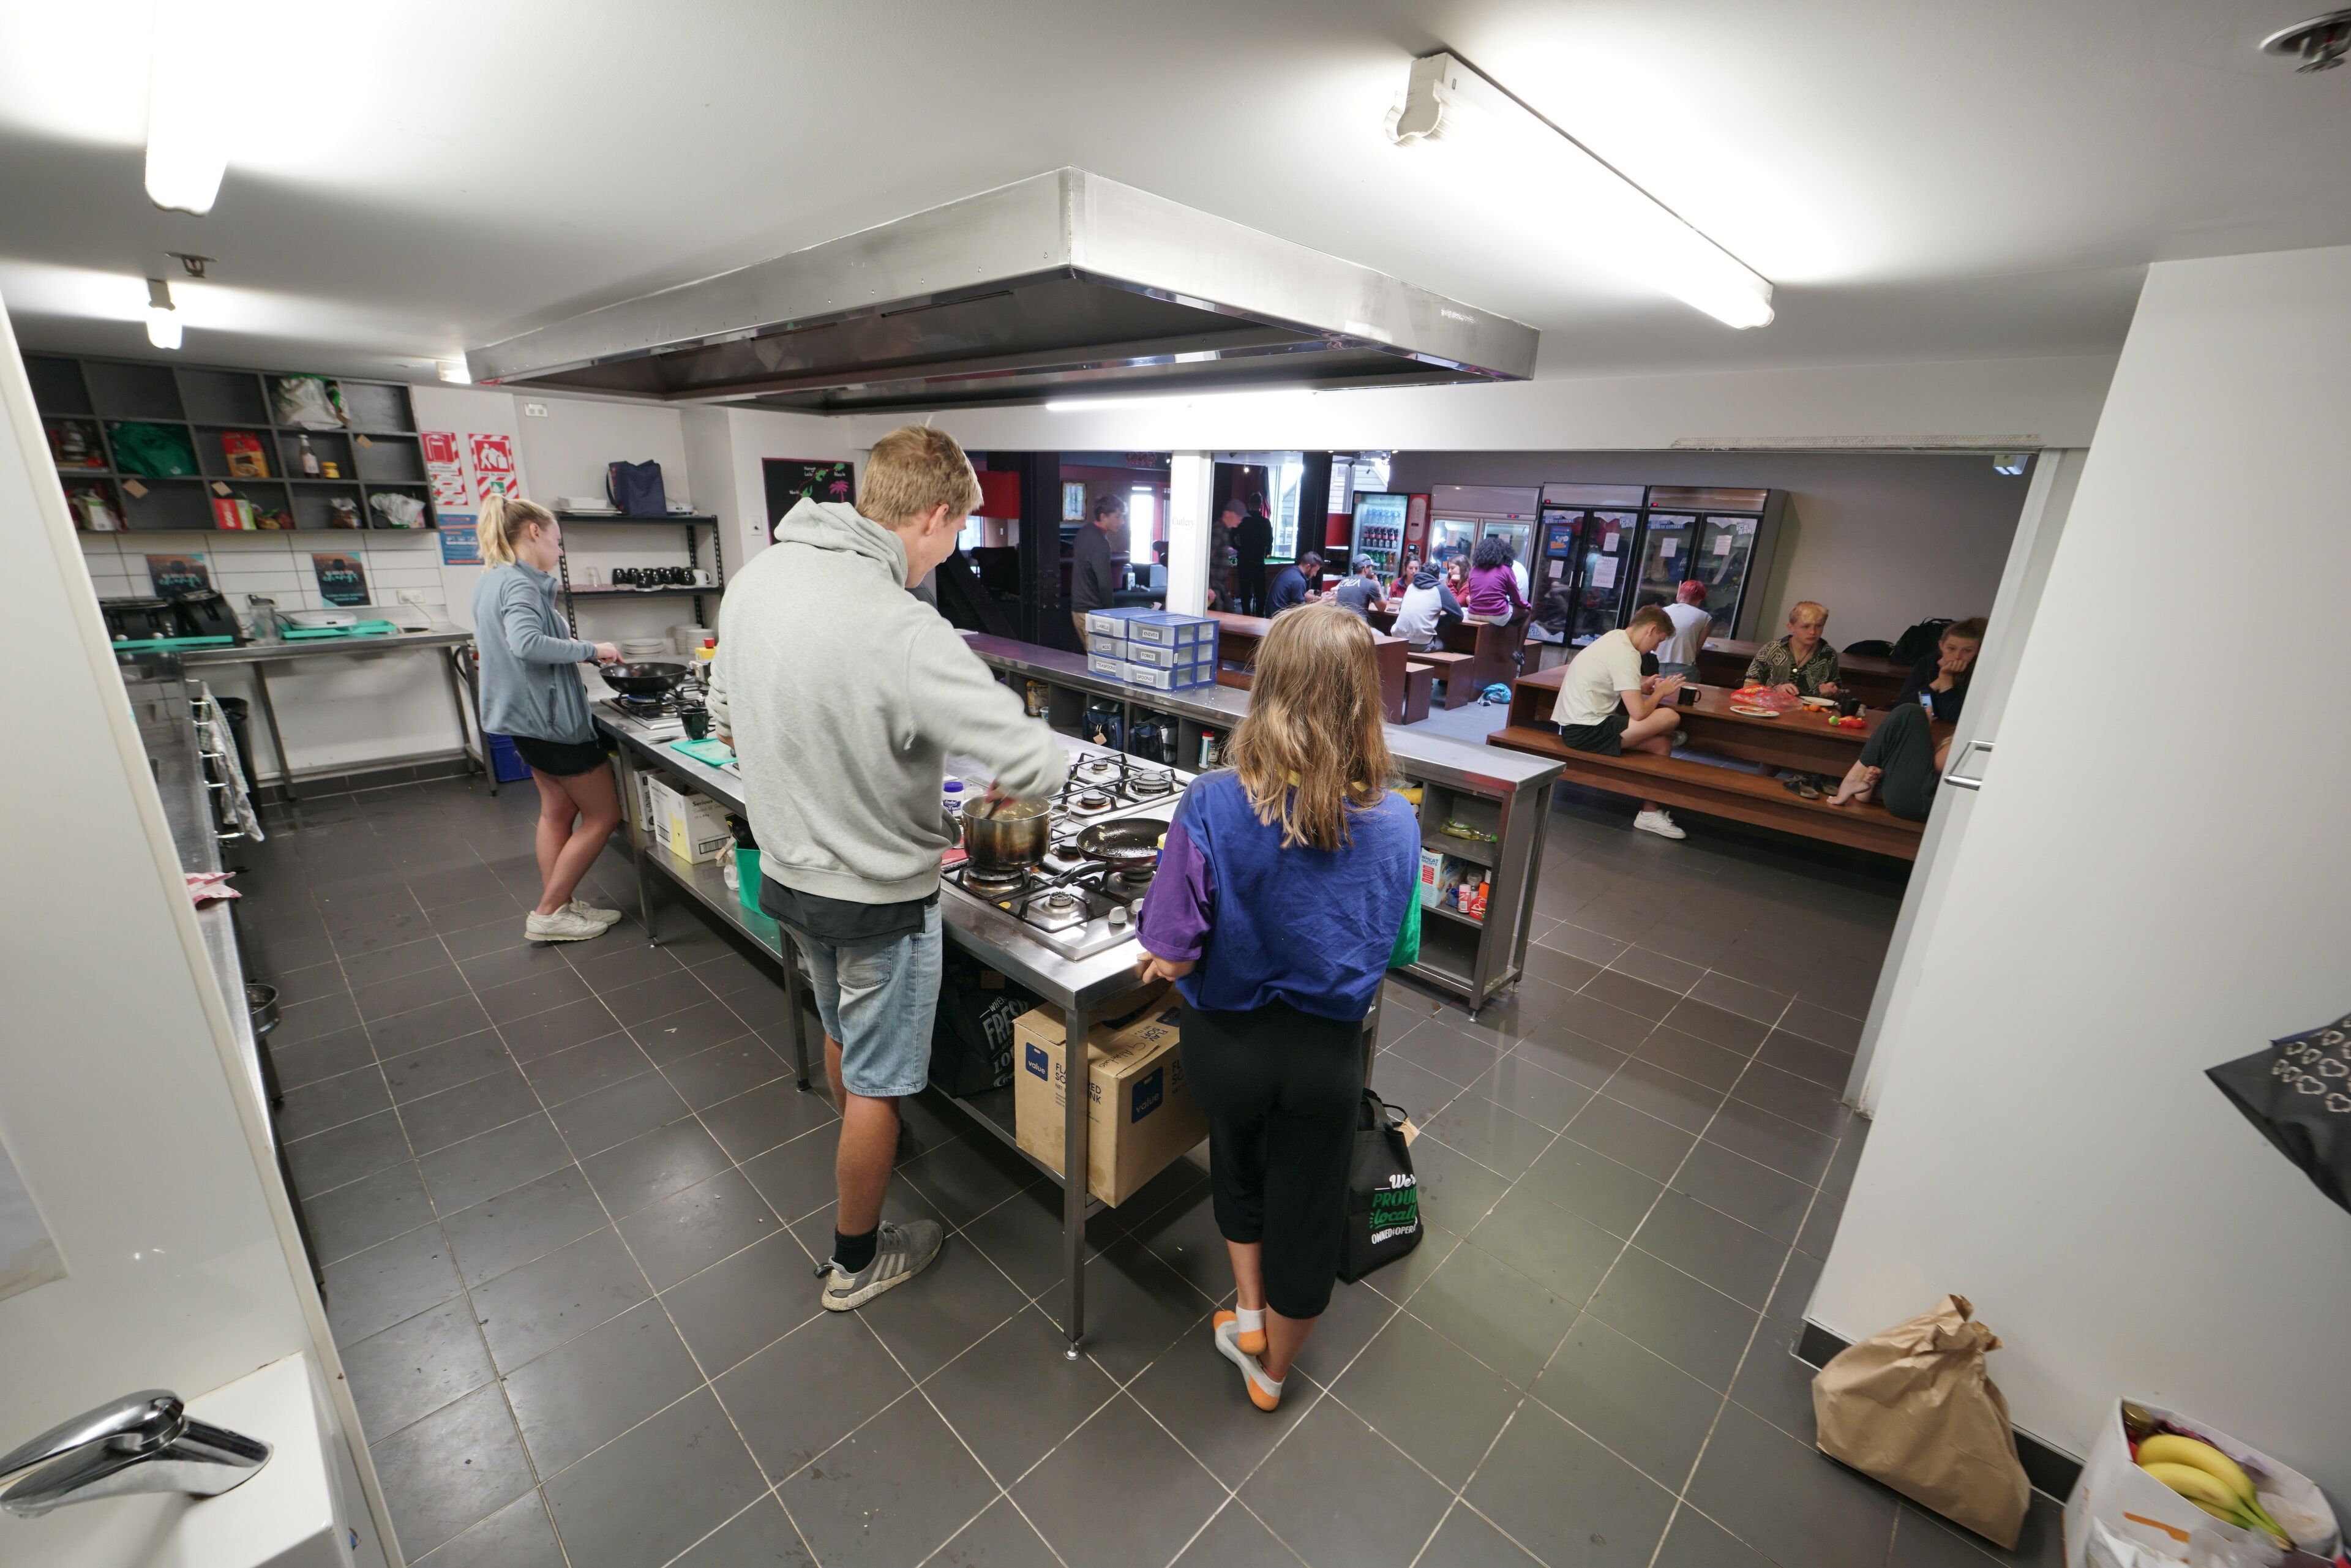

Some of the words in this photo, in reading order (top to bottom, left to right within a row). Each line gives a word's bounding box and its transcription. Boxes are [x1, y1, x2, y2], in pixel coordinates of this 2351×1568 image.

[1172, 517, 1194, 528] Cutlery
[1028, 1060, 1046, 1075] value
[1136, 1093, 1160, 1113] value
